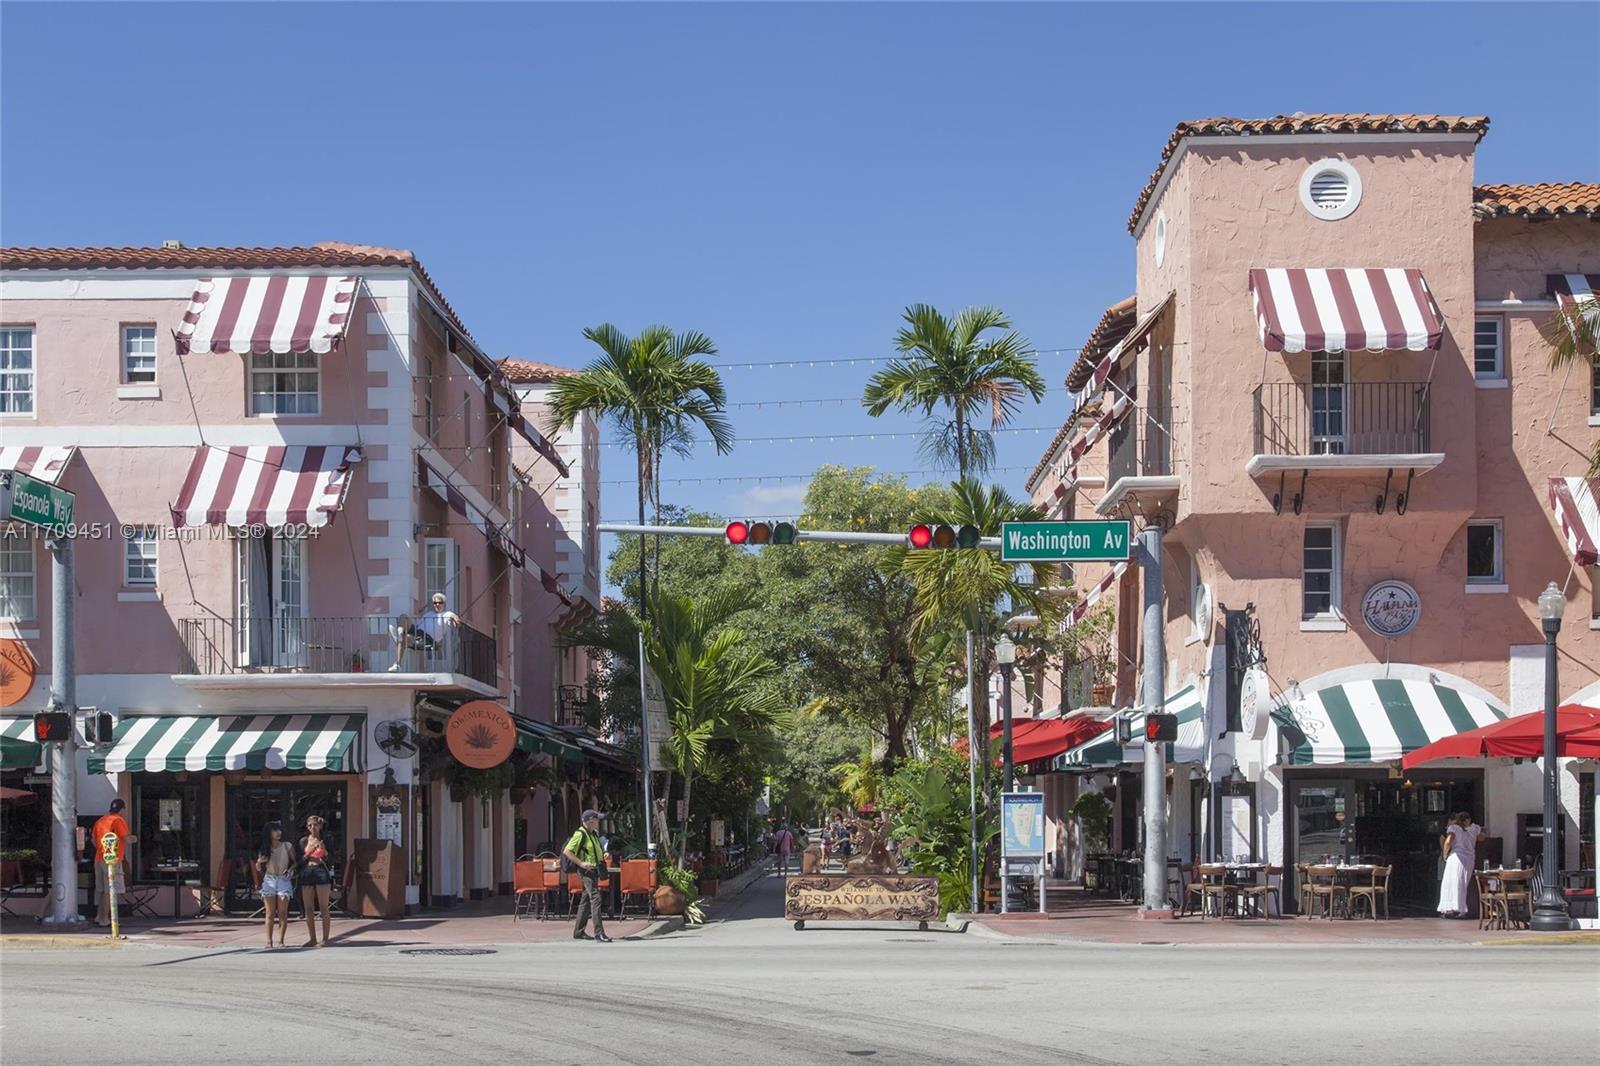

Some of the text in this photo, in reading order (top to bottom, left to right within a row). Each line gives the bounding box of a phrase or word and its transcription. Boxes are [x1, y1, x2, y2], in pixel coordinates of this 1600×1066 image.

[13, 484, 72, 527] Espanola Way
[1008, 530, 1123, 555] Washington Av
[803, 893, 920, 905] ESPAÑOLA WAY
